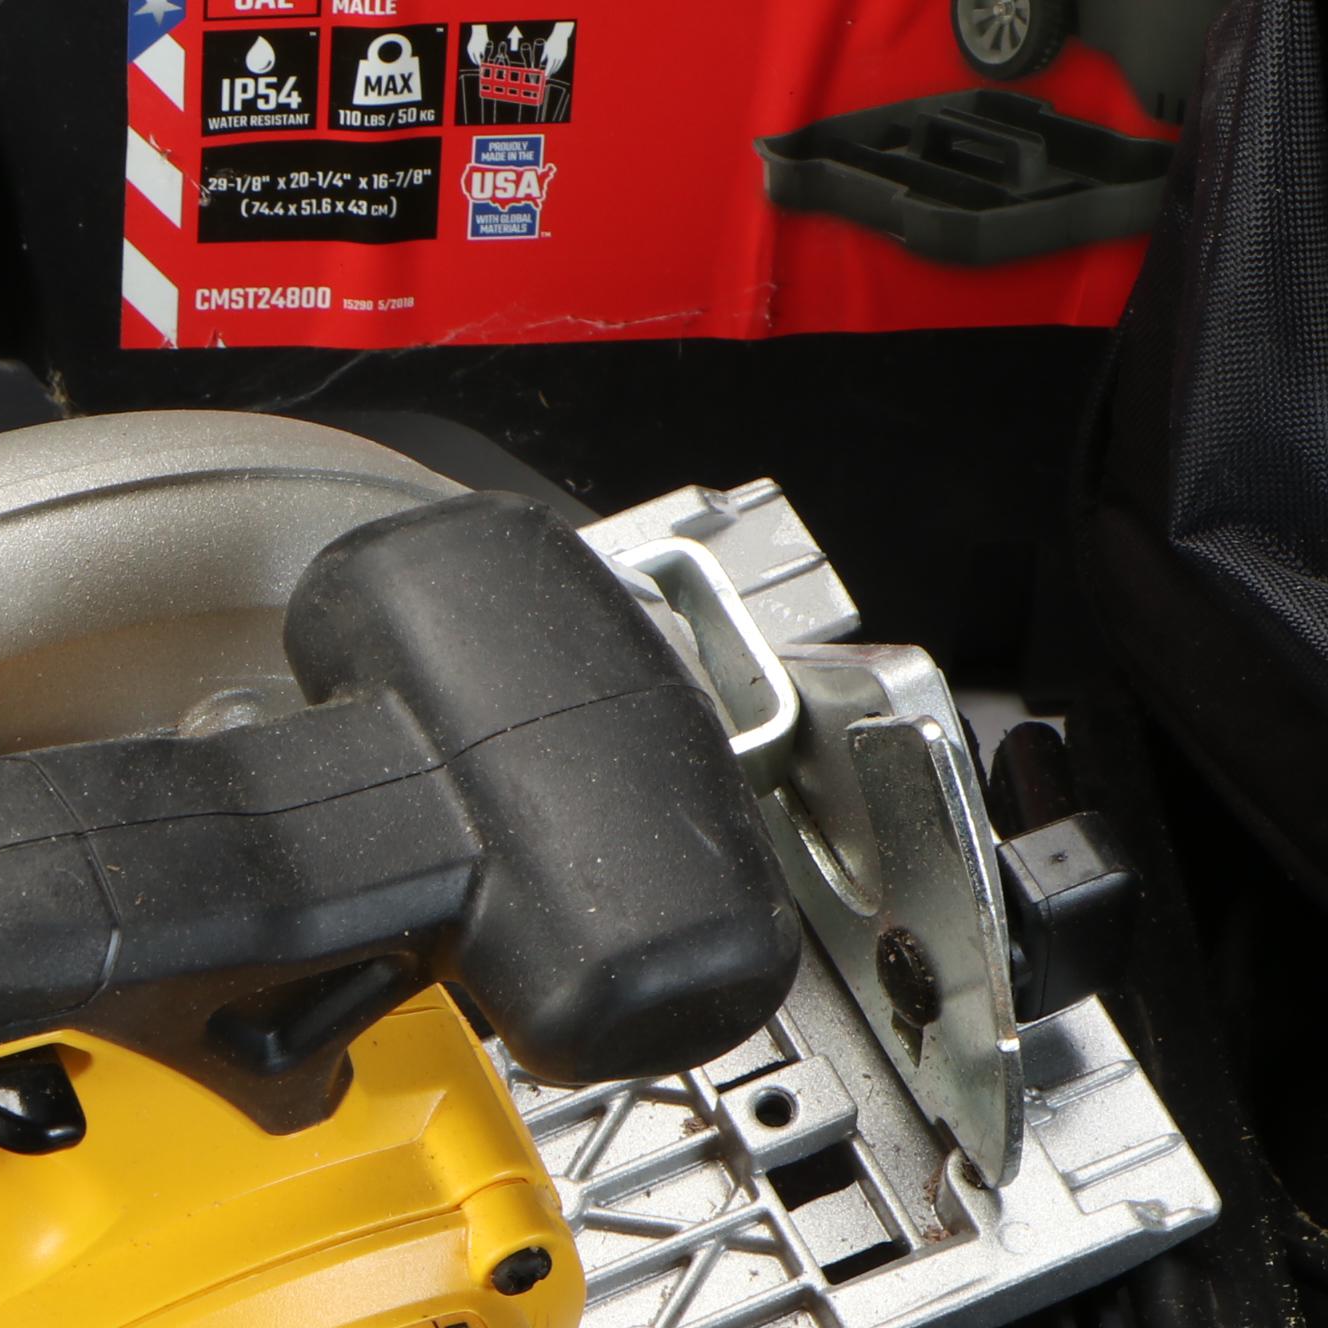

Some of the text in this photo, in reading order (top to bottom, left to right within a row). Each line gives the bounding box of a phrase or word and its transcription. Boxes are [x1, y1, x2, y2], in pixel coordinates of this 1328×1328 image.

[332, 0, 397, 15] MALLE
[364, 72, 414, 97] MAX
[221, 76, 302, 112] IP54
[208, 113, 310, 130] WATER RESISTANT
[338, 109, 361, 126] 110
[364, 115, 385, 127] LBS
[397, 107, 417, 124] 50
[420, 109, 435, 122] KG
[489, 141, 528, 152] PROUDLY
[481, 151, 534, 162] MADE IN THE
[208, 175, 270, 193] 29-1/8"
[290, 171, 351, 189] 20-1/4"
[372, 169, 431, 189] 16-7/8"
[472, 170, 542, 199] USA
[301, 198, 331, 215] 51.6
[347, 199, 367, 215] 43
[476, 213, 532, 224] WITH GLOBAL
[480, 223, 528, 234] MATERIALS
[195, 287, 414, 311] CMST24800 15290 5/2018
